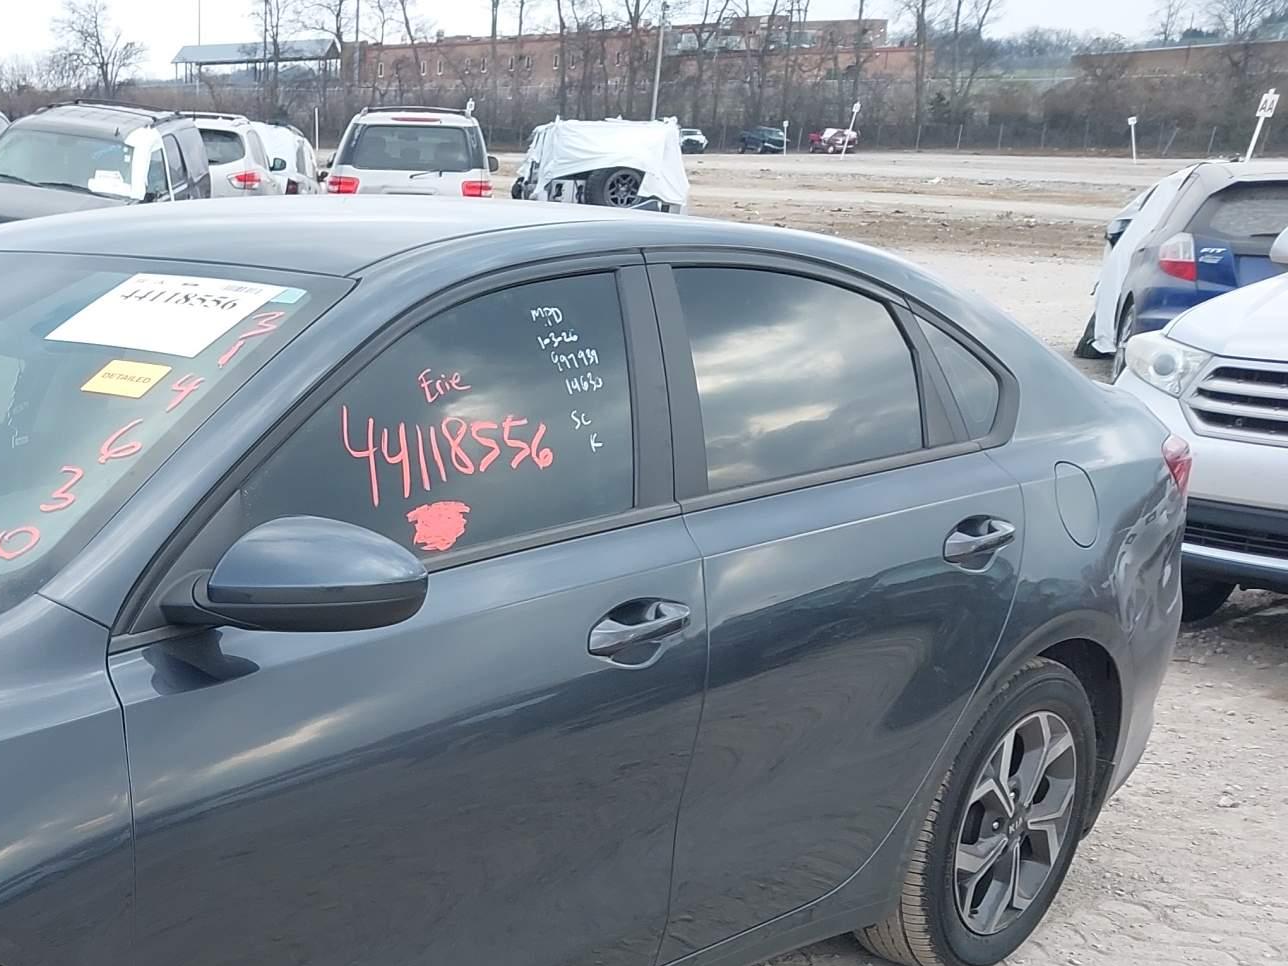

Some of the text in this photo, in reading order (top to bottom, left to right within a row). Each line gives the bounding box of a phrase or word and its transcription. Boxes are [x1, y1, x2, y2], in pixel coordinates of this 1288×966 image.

[101, 371, 152, 384] DETAILED
[417, 368, 472, 403] Erie
[342, 404, 554, 508] 44118556
